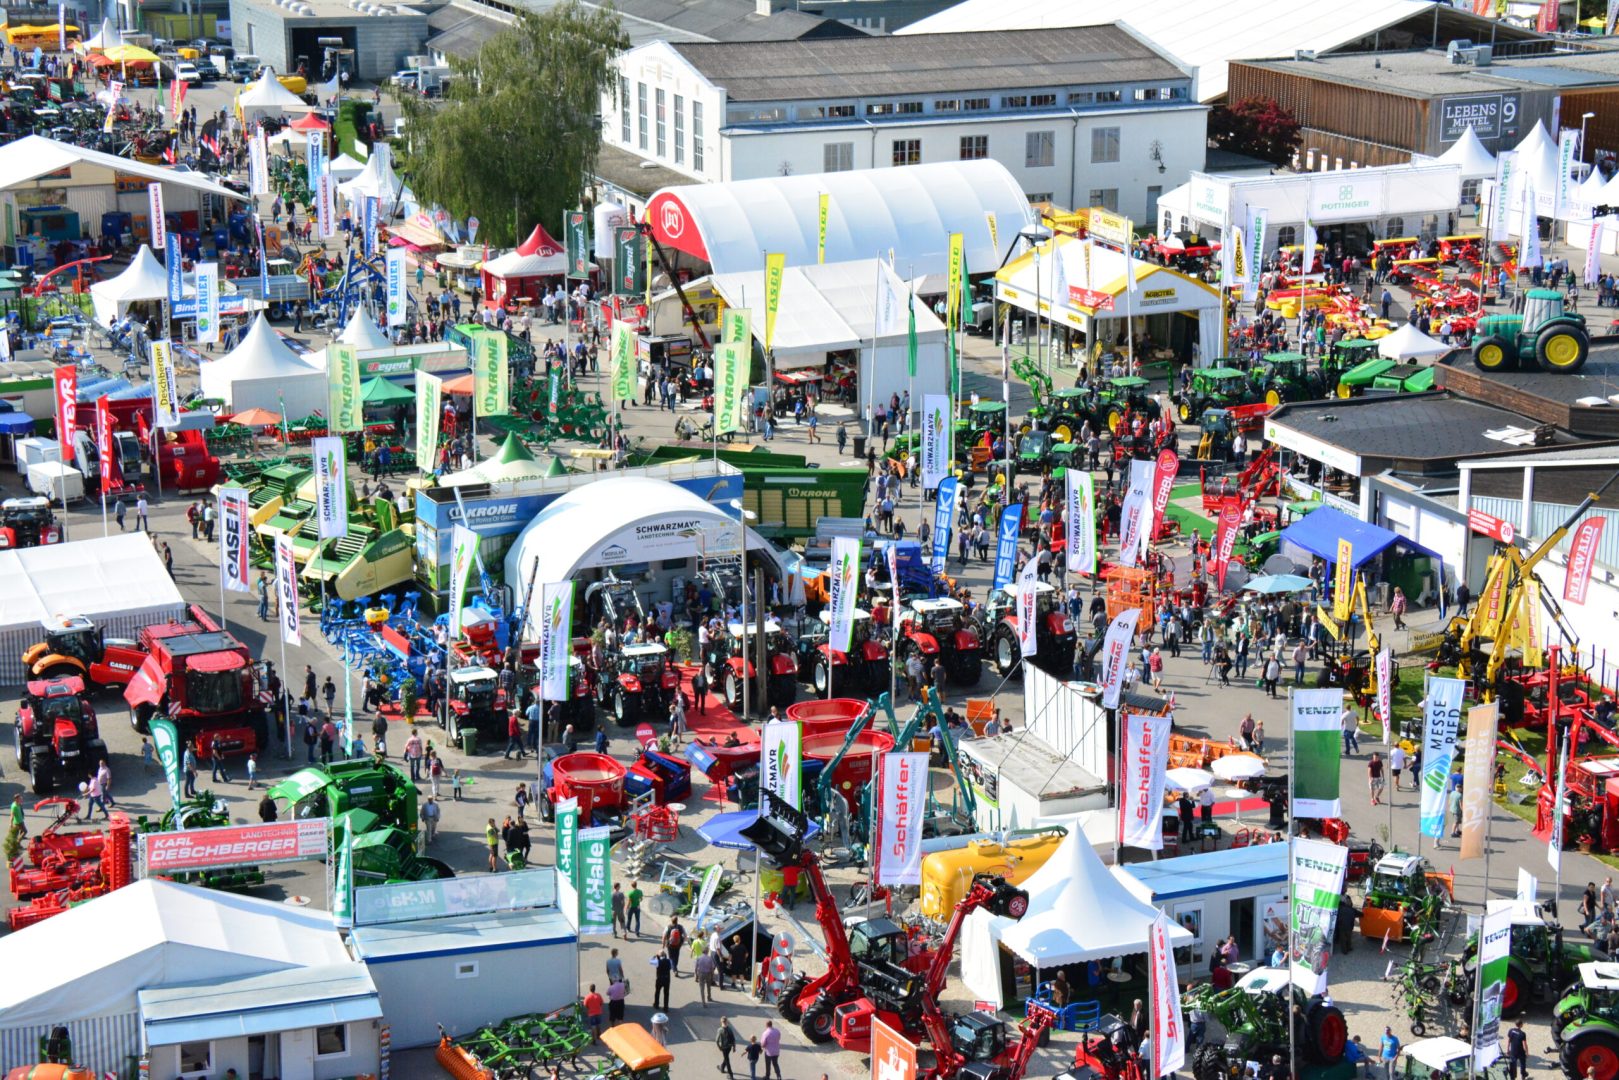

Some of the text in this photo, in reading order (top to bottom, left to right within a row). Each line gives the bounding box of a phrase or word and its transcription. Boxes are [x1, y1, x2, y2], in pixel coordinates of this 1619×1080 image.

[1446, 104, 1497, 119] LEBENS
[1452, 116, 1490, 127] MITTEL
[1503, 102, 1516, 123] 9
[170, 236, 181, 302] Binderberger
[388, 259, 399, 297] BAUER
[198, 274, 208, 313] BAUER
[733, 314, 744, 343] ONE
[155, 346, 169, 406] Deschberger
[340, 350, 352, 410] KRONE
[486, 338, 498, 395] KRONE
[724, 348, 736, 411] KRONE
[60, 377, 76, 447] STEYR
[421, 381, 434, 447] KRONE
[926, 413, 934, 474] SCHWARZMAYR
[322, 457, 331, 522] SCHWARZMAYR
[799, 489, 837, 497] KRONE
[1155, 474, 1175, 513] KERBL
[466, 504, 518, 518] KRONE
[636, 520, 701, 534] SCHWARZMAYR
[932, 487, 952, 553] ISEKI
[1073, 489, 1081, 555] SCHWARZMAYR
[1128, 508, 1139, 547] HYDRAC
[226, 519, 240, 580] CASE
[637, 532, 675, 540] LANDTECHNIK
[996, 514, 1018, 587] ISEKI
[1219, 525, 1238, 563] KERBL
[1502, 525, 1511, 537] 20
[1569, 525, 1594, 600] MAXWALD
[282, 569, 297, 632] CASE
[542, 605, 553, 681] SCHWARZMAYR
[1109, 642, 1123, 686] HYDRAC
[1297, 705, 1340, 716] FENDT
[1431, 700, 1447, 750] MESSE
[1445, 708, 1460, 744] RIED
[1136, 722, 1152, 825] Schäffer
[893, 757, 909, 862] Schäffer
[151, 838, 297, 861] DESCHBERGER
[154, 837, 194, 848] KARL
[240, 829, 296, 840] LANDTECHNIK
[585, 843, 606, 922] McHale
[1295, 857, 1344, 875] FENDT
[1011, 901, 1024, 912] 0%
[1484, 928, 1511, 945] FENDT
